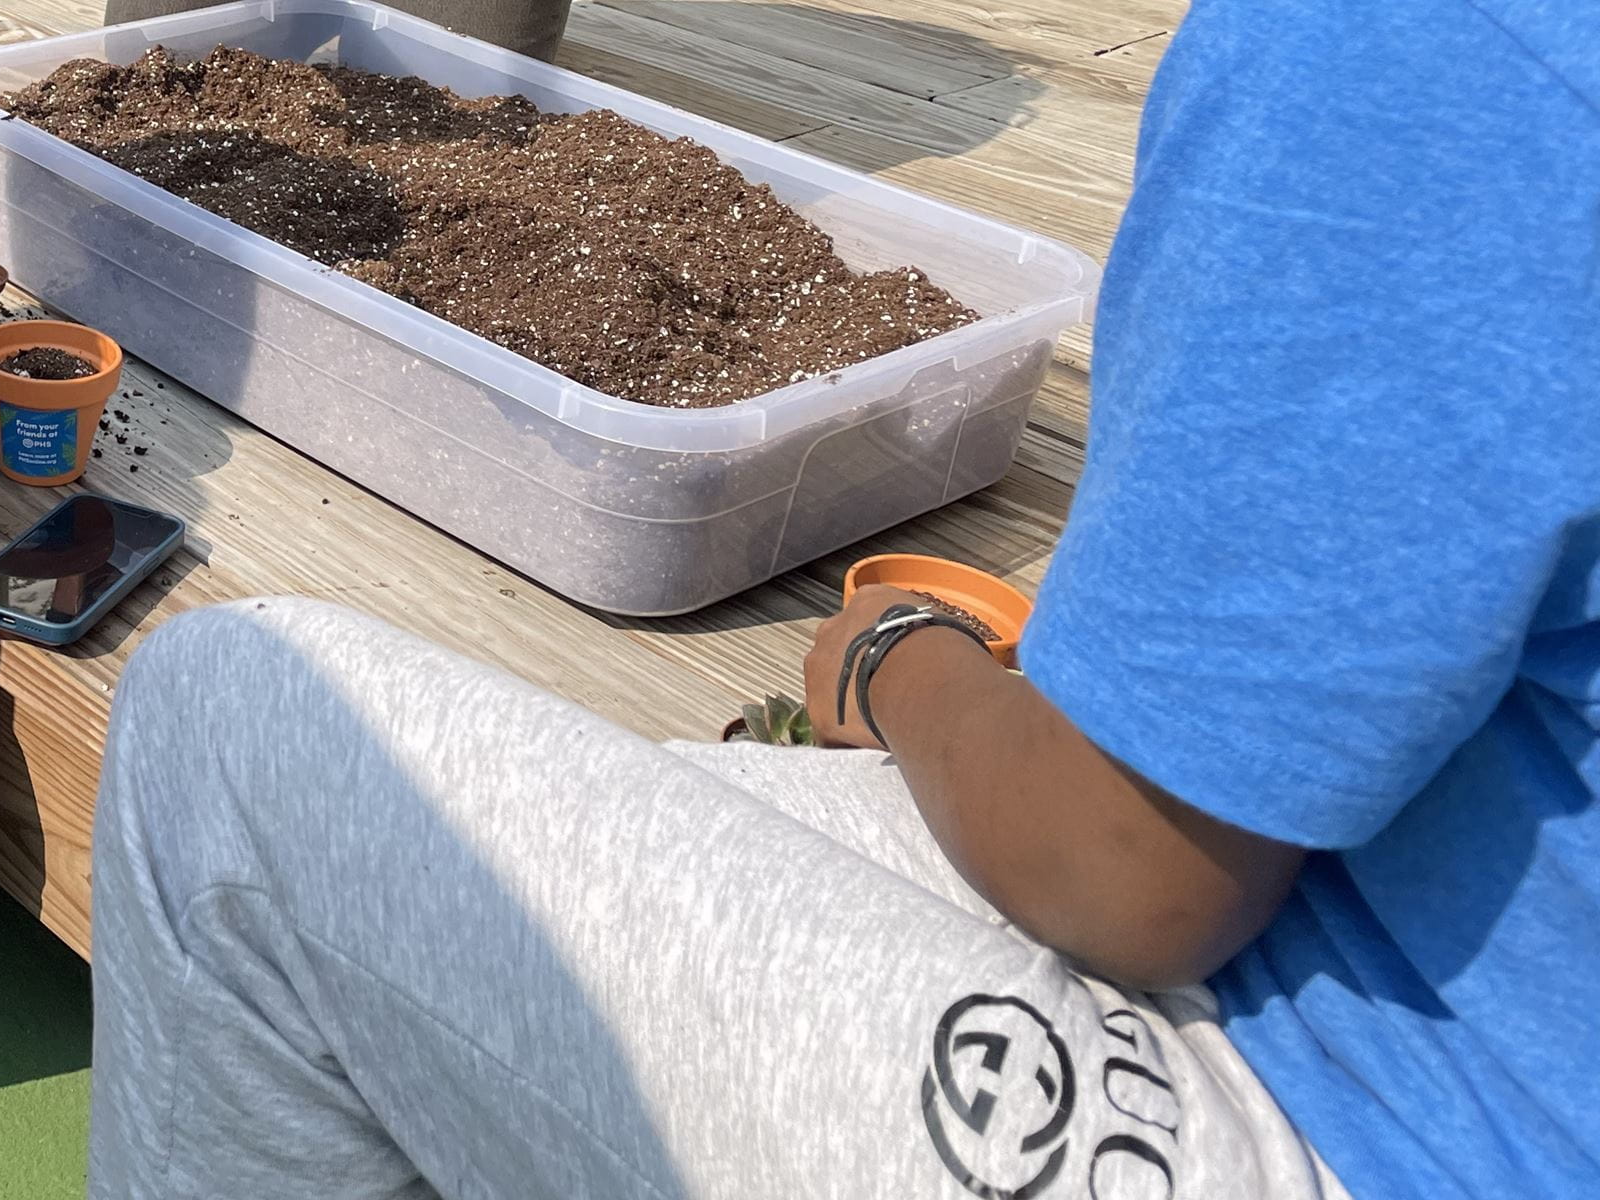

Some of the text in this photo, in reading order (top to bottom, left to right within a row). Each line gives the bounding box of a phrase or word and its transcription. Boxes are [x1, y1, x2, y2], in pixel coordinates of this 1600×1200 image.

[16, 419, 59, 432] From your
[16, 428, 47, 438] friends
